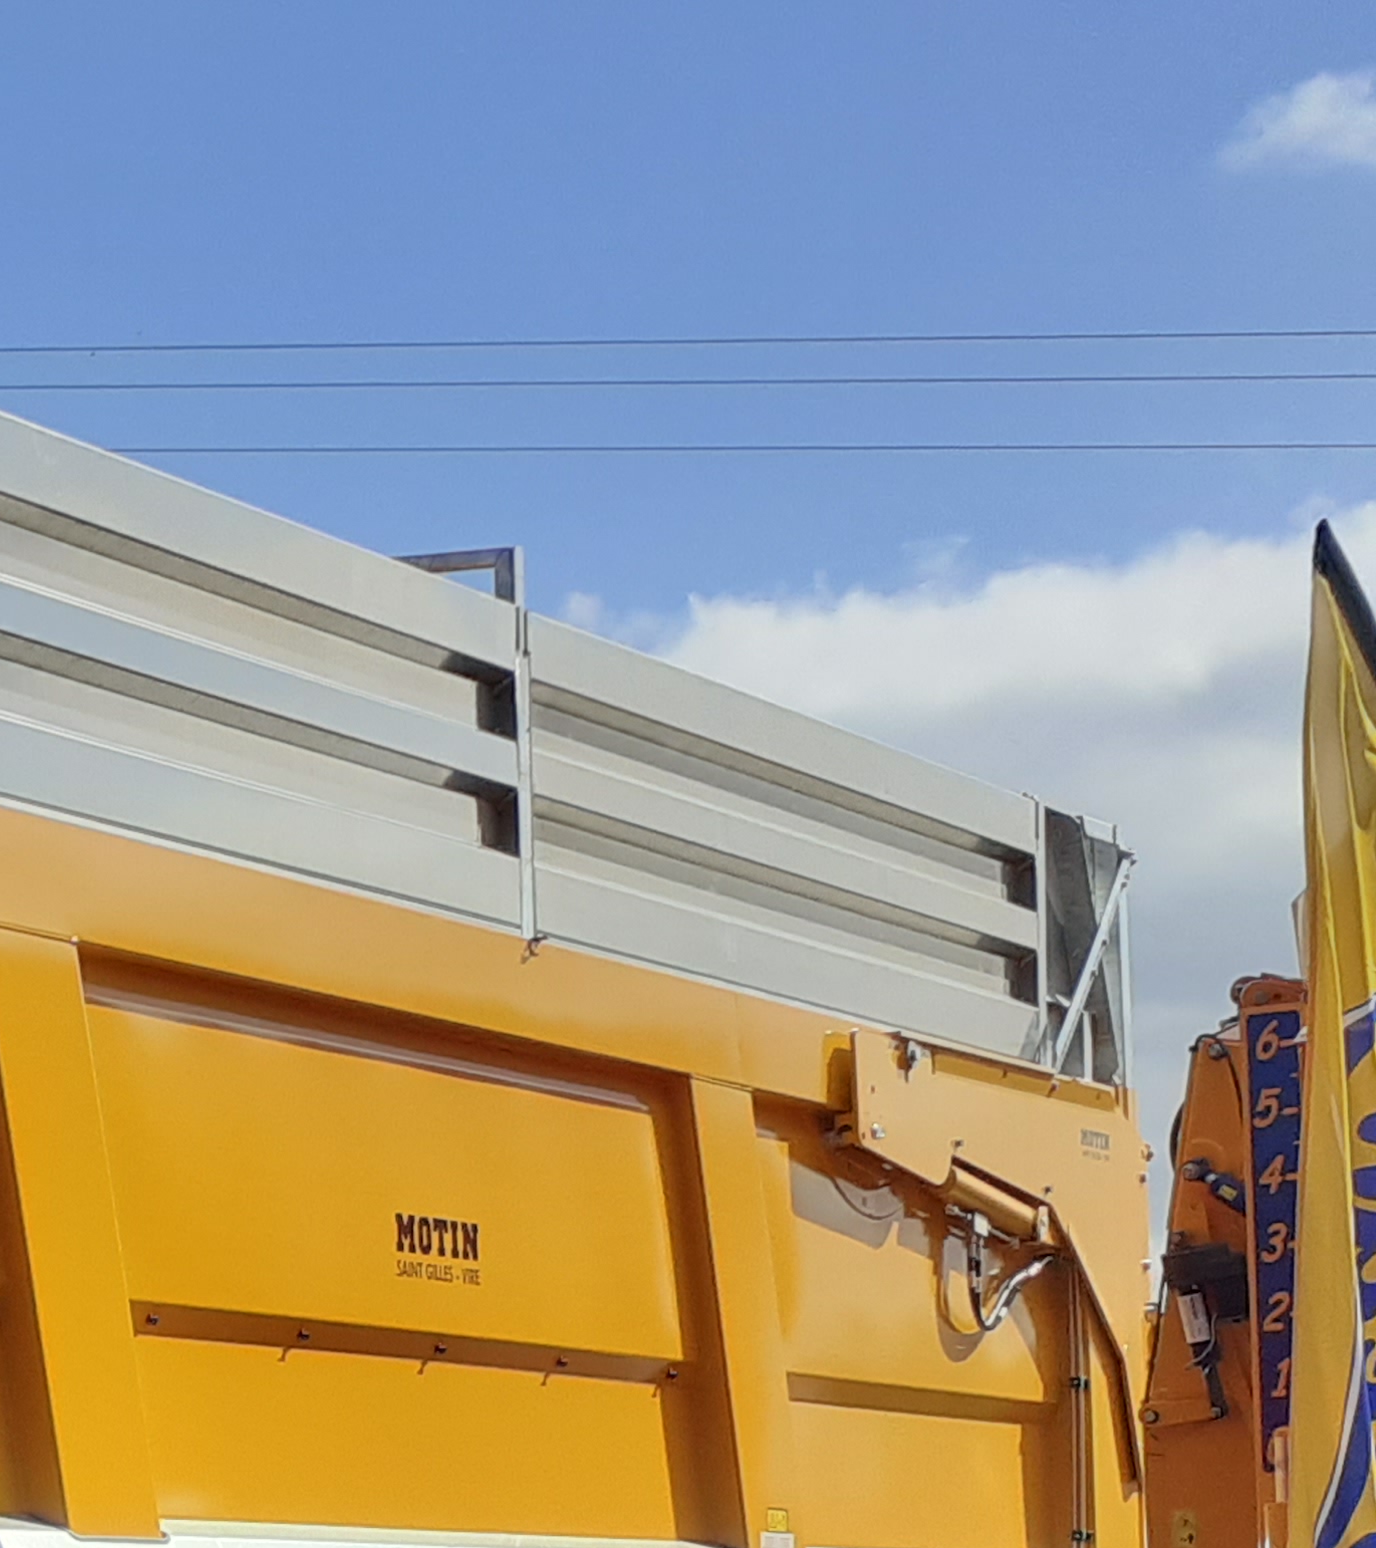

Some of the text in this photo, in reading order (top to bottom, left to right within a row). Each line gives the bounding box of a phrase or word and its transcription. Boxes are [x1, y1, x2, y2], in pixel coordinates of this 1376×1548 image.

[1255, 1018, 1281, 1062] 6
[1253, 1086, 1283, 1129] 5
[1258, 1153, 1286, 1195] 4
[395, 1212, 479, 1261] MOTIN
[1260, 1222, 1288, 1264] 3
[396, 1260, 423, 1279] SAINT
[425, 1263, 454, 1283] GILLES
[1263, 1291, 1291, 1333] 2
[1271, 1357, 1291, 1398] 1
